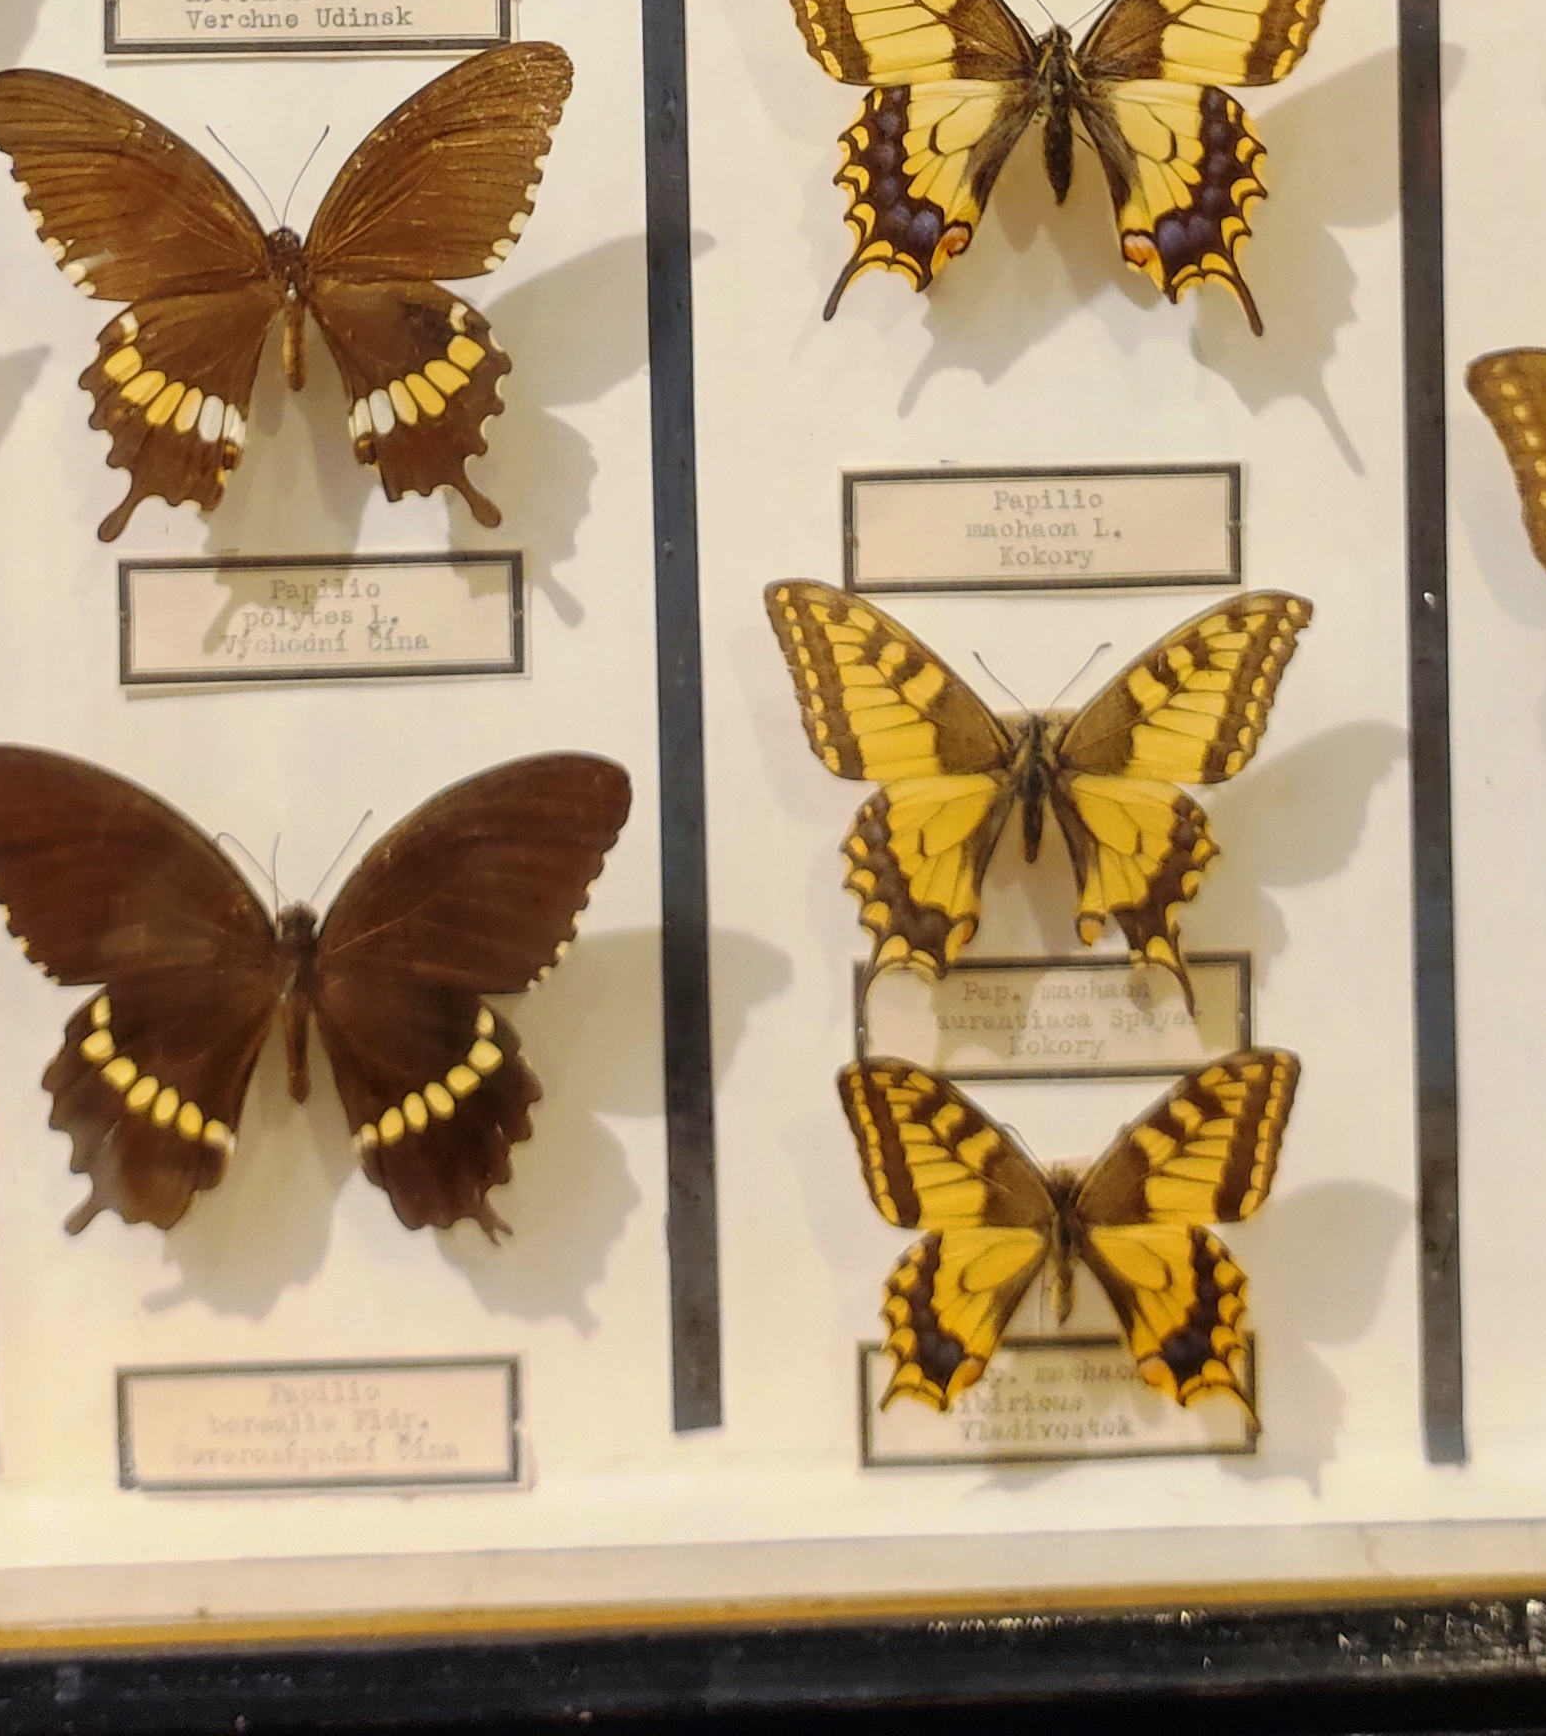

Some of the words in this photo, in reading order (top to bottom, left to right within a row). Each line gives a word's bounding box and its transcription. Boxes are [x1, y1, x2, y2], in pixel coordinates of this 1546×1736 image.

[186, 8, 300, 29] Verchne
[315, 6, 414, 29] Udinsk
[992, 488, 1104, 515] Papilio
[965, 516, 1079, 540] machaon
[1094, 516, 1123, 539] L.
[998, 543, 1095, 571] Kokory
[269, 576, 381, 604] Papilio
[243, 605, 357, 632] polytes
[370, 604, 400, 627] L.
[220, 627, 350, 658] Východní
[367, 623, 430, 653] Čína
[961, 980, 1022, 1009] Pap.
[1039, 976, 1151, 1002] machaon
[1008, 1033, 1107, 1061] Kokory
[953, 1391, 1084, 1417] ibiricus
[957, 1415, 1134, 1441] Vladivostok
